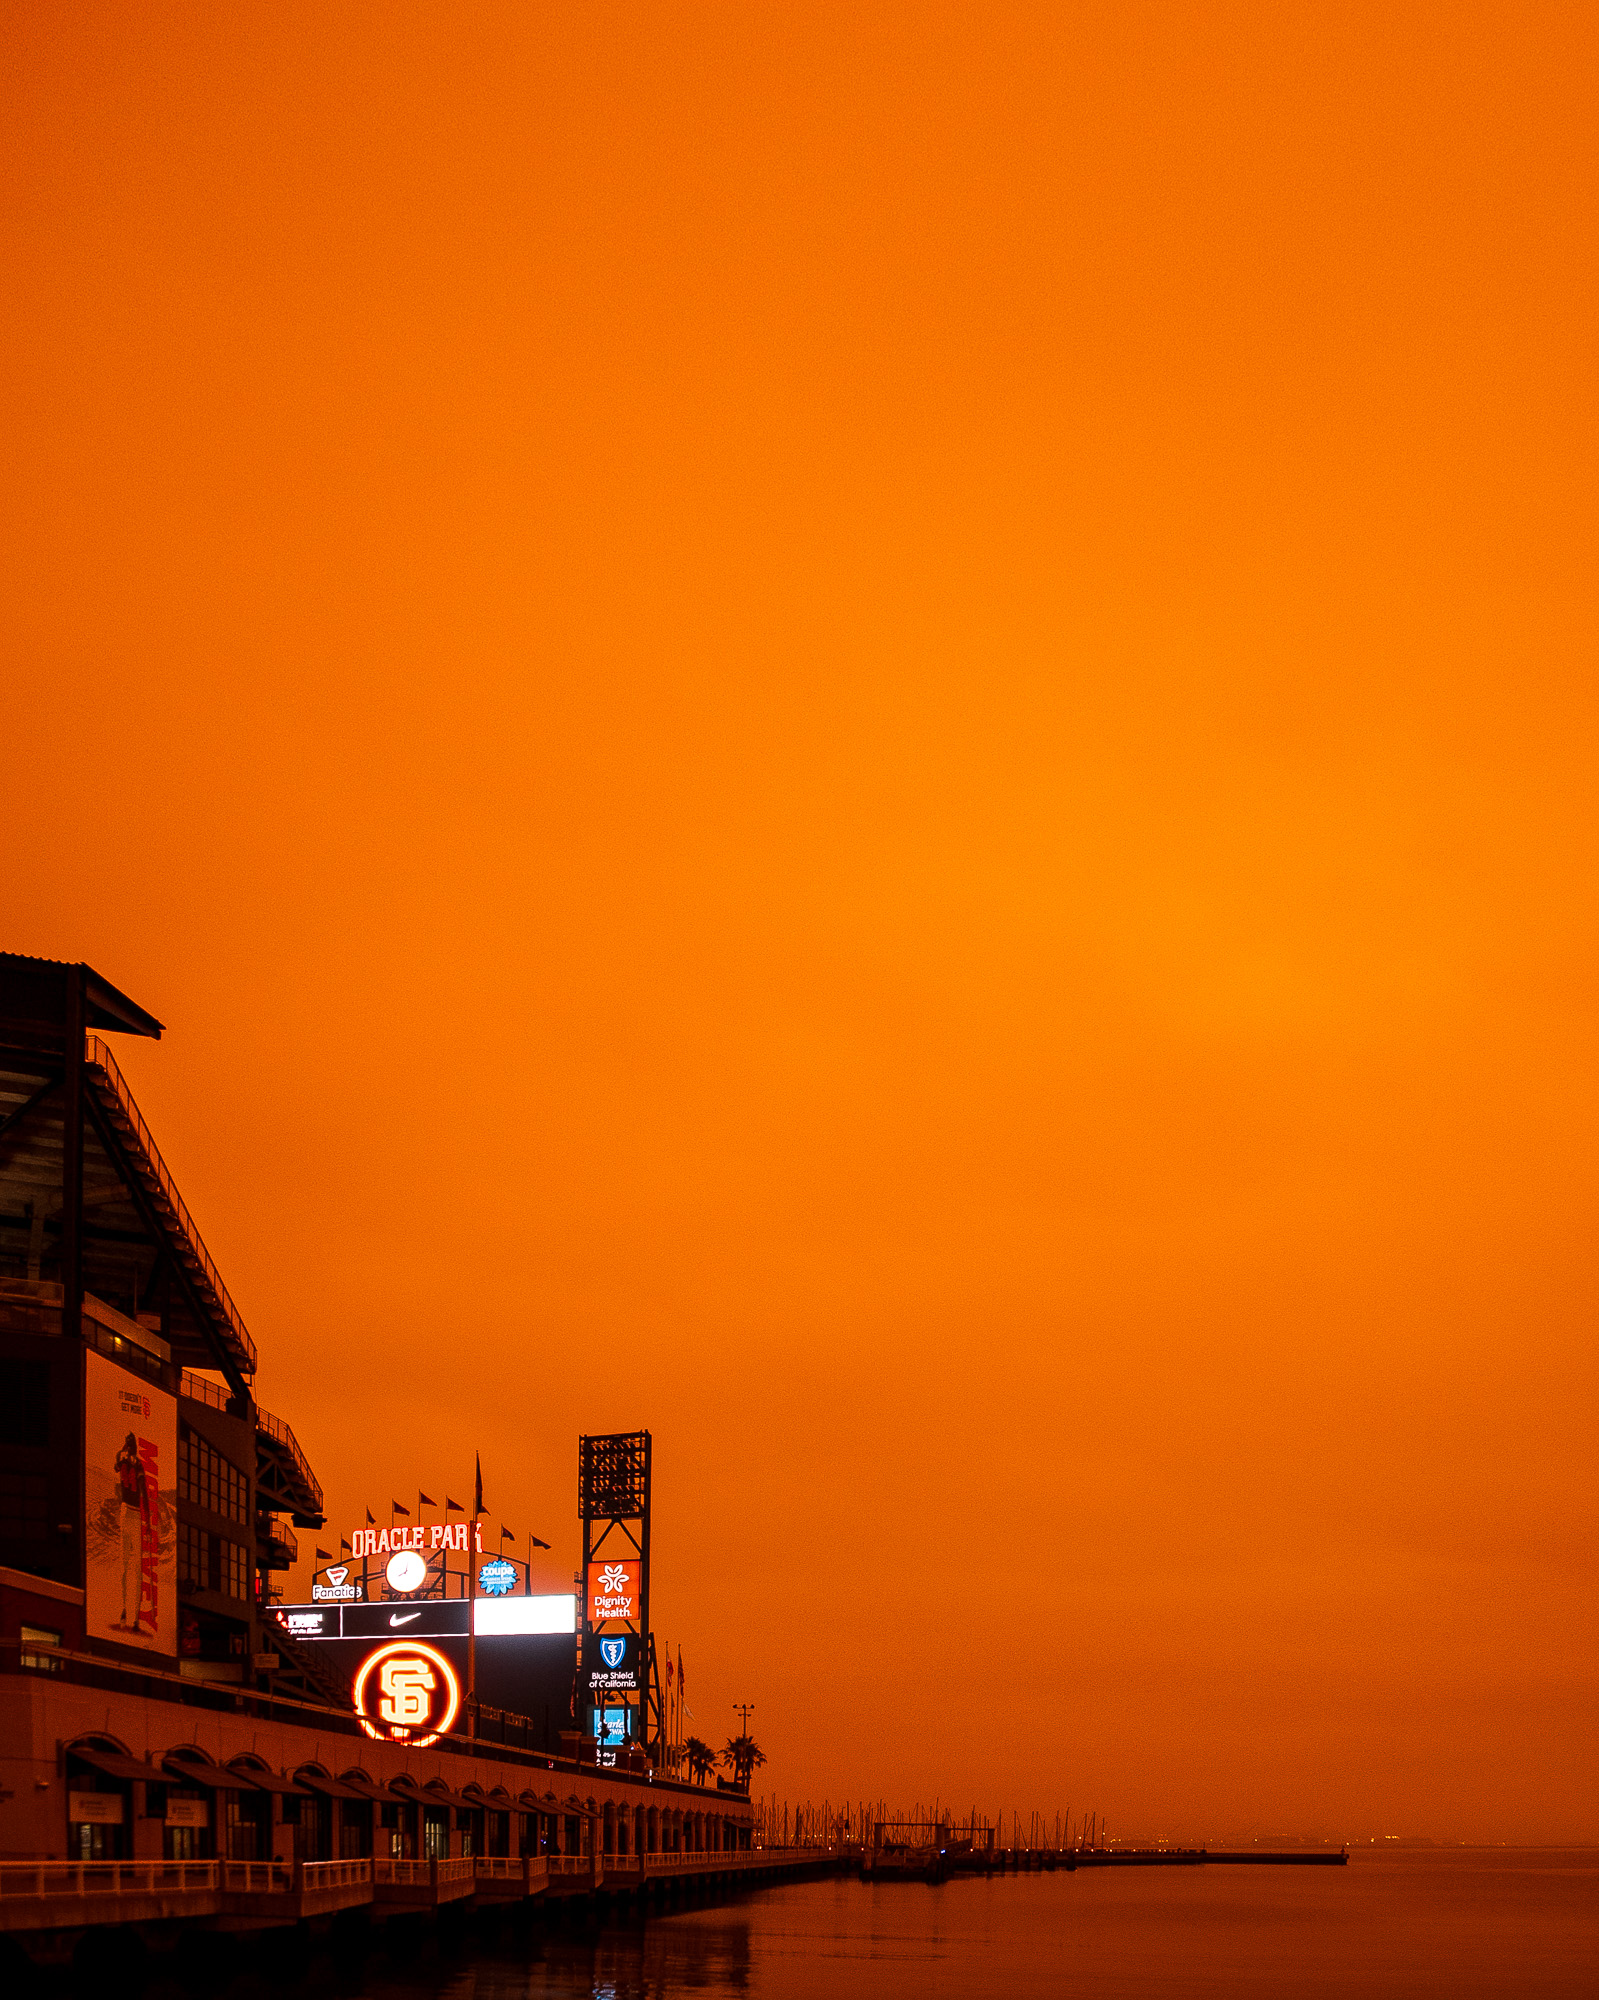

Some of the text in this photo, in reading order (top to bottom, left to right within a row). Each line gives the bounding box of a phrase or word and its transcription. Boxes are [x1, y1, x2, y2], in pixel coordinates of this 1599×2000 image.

[352, 1526, 425, 1559] ORACLE
[482, 1566, 514, 1578] coupa
[594, 1595, 632, 1608] Dignity
[591, 1671, 634, 1680] Blue Shield
[588, 1679, 637, 1688] of California
